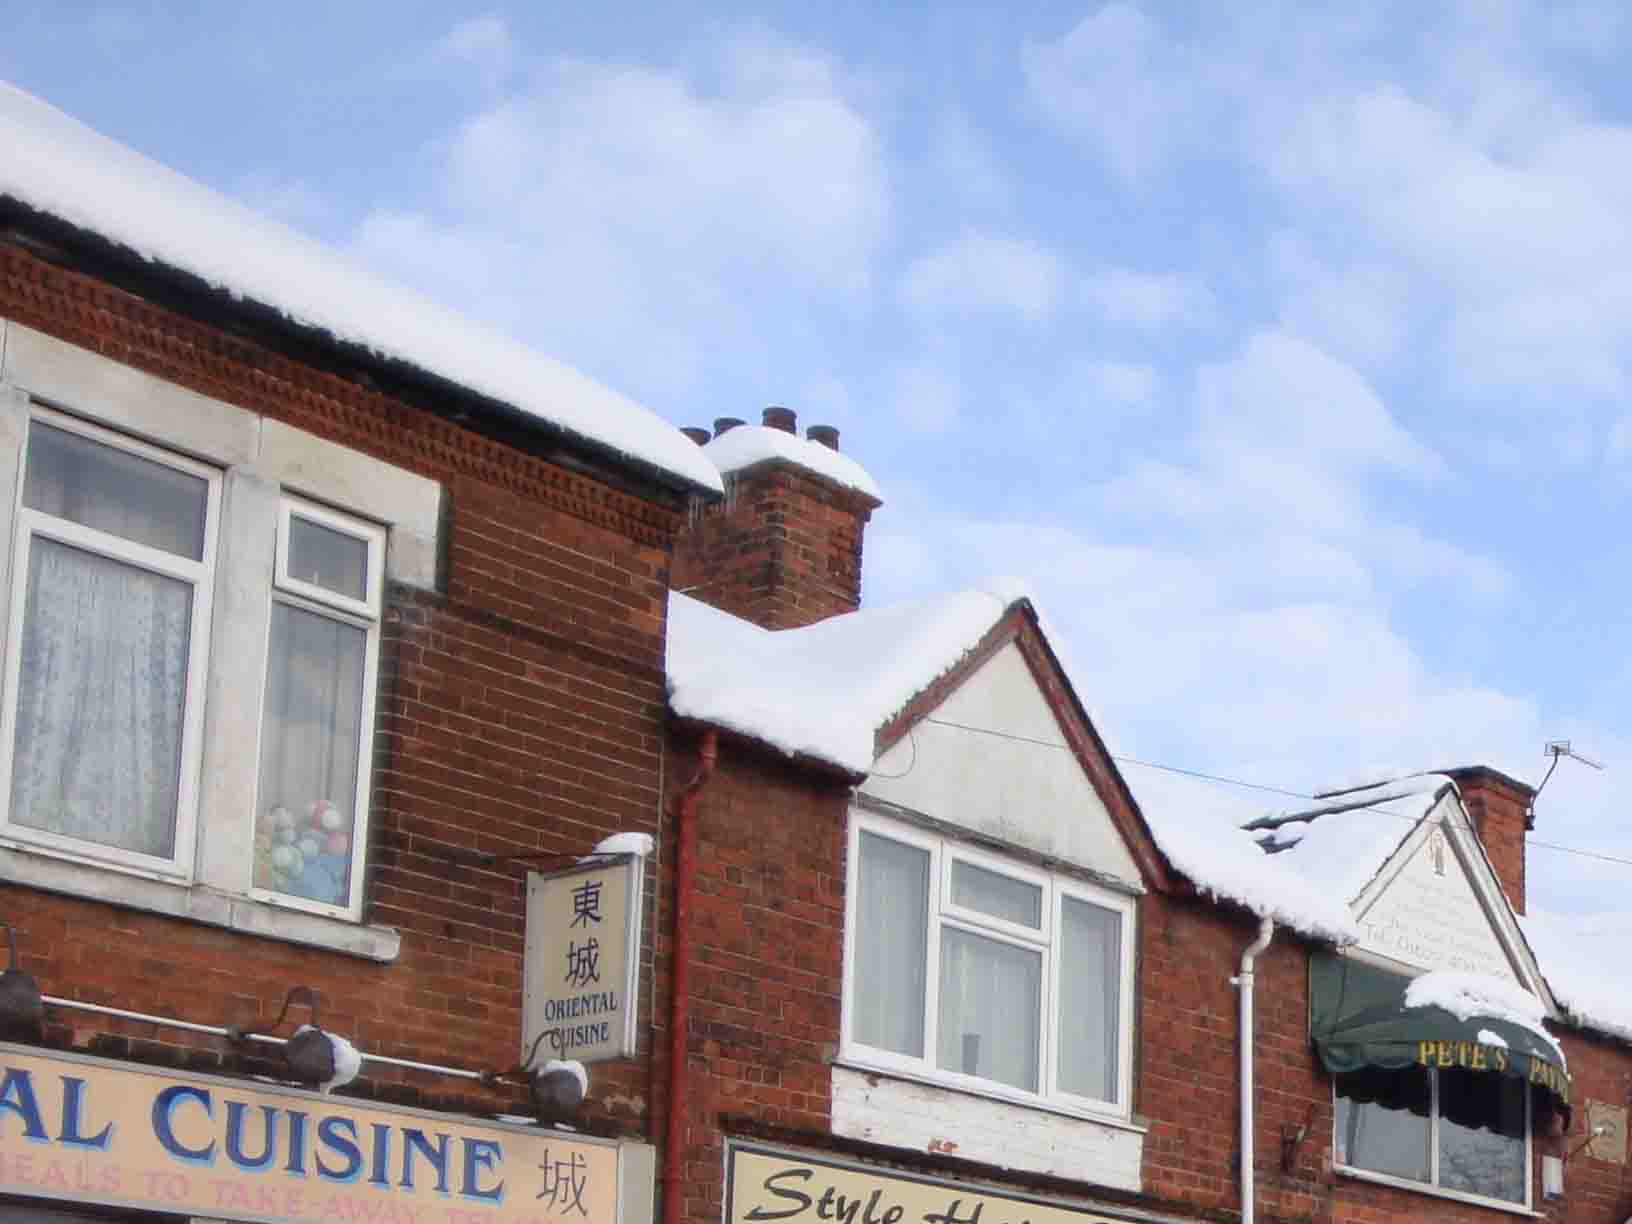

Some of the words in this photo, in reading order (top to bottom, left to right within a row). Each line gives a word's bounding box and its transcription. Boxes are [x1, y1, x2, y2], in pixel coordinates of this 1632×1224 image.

[564, 879, 604, 988] 東城
[544, 991, 618, 1021] ORIENTAL
[550, 1021, 610, 1049] CUISINE
[150, 1084, 507, 1210] CUISINE
[535, 1147, 589, 1218] 城
